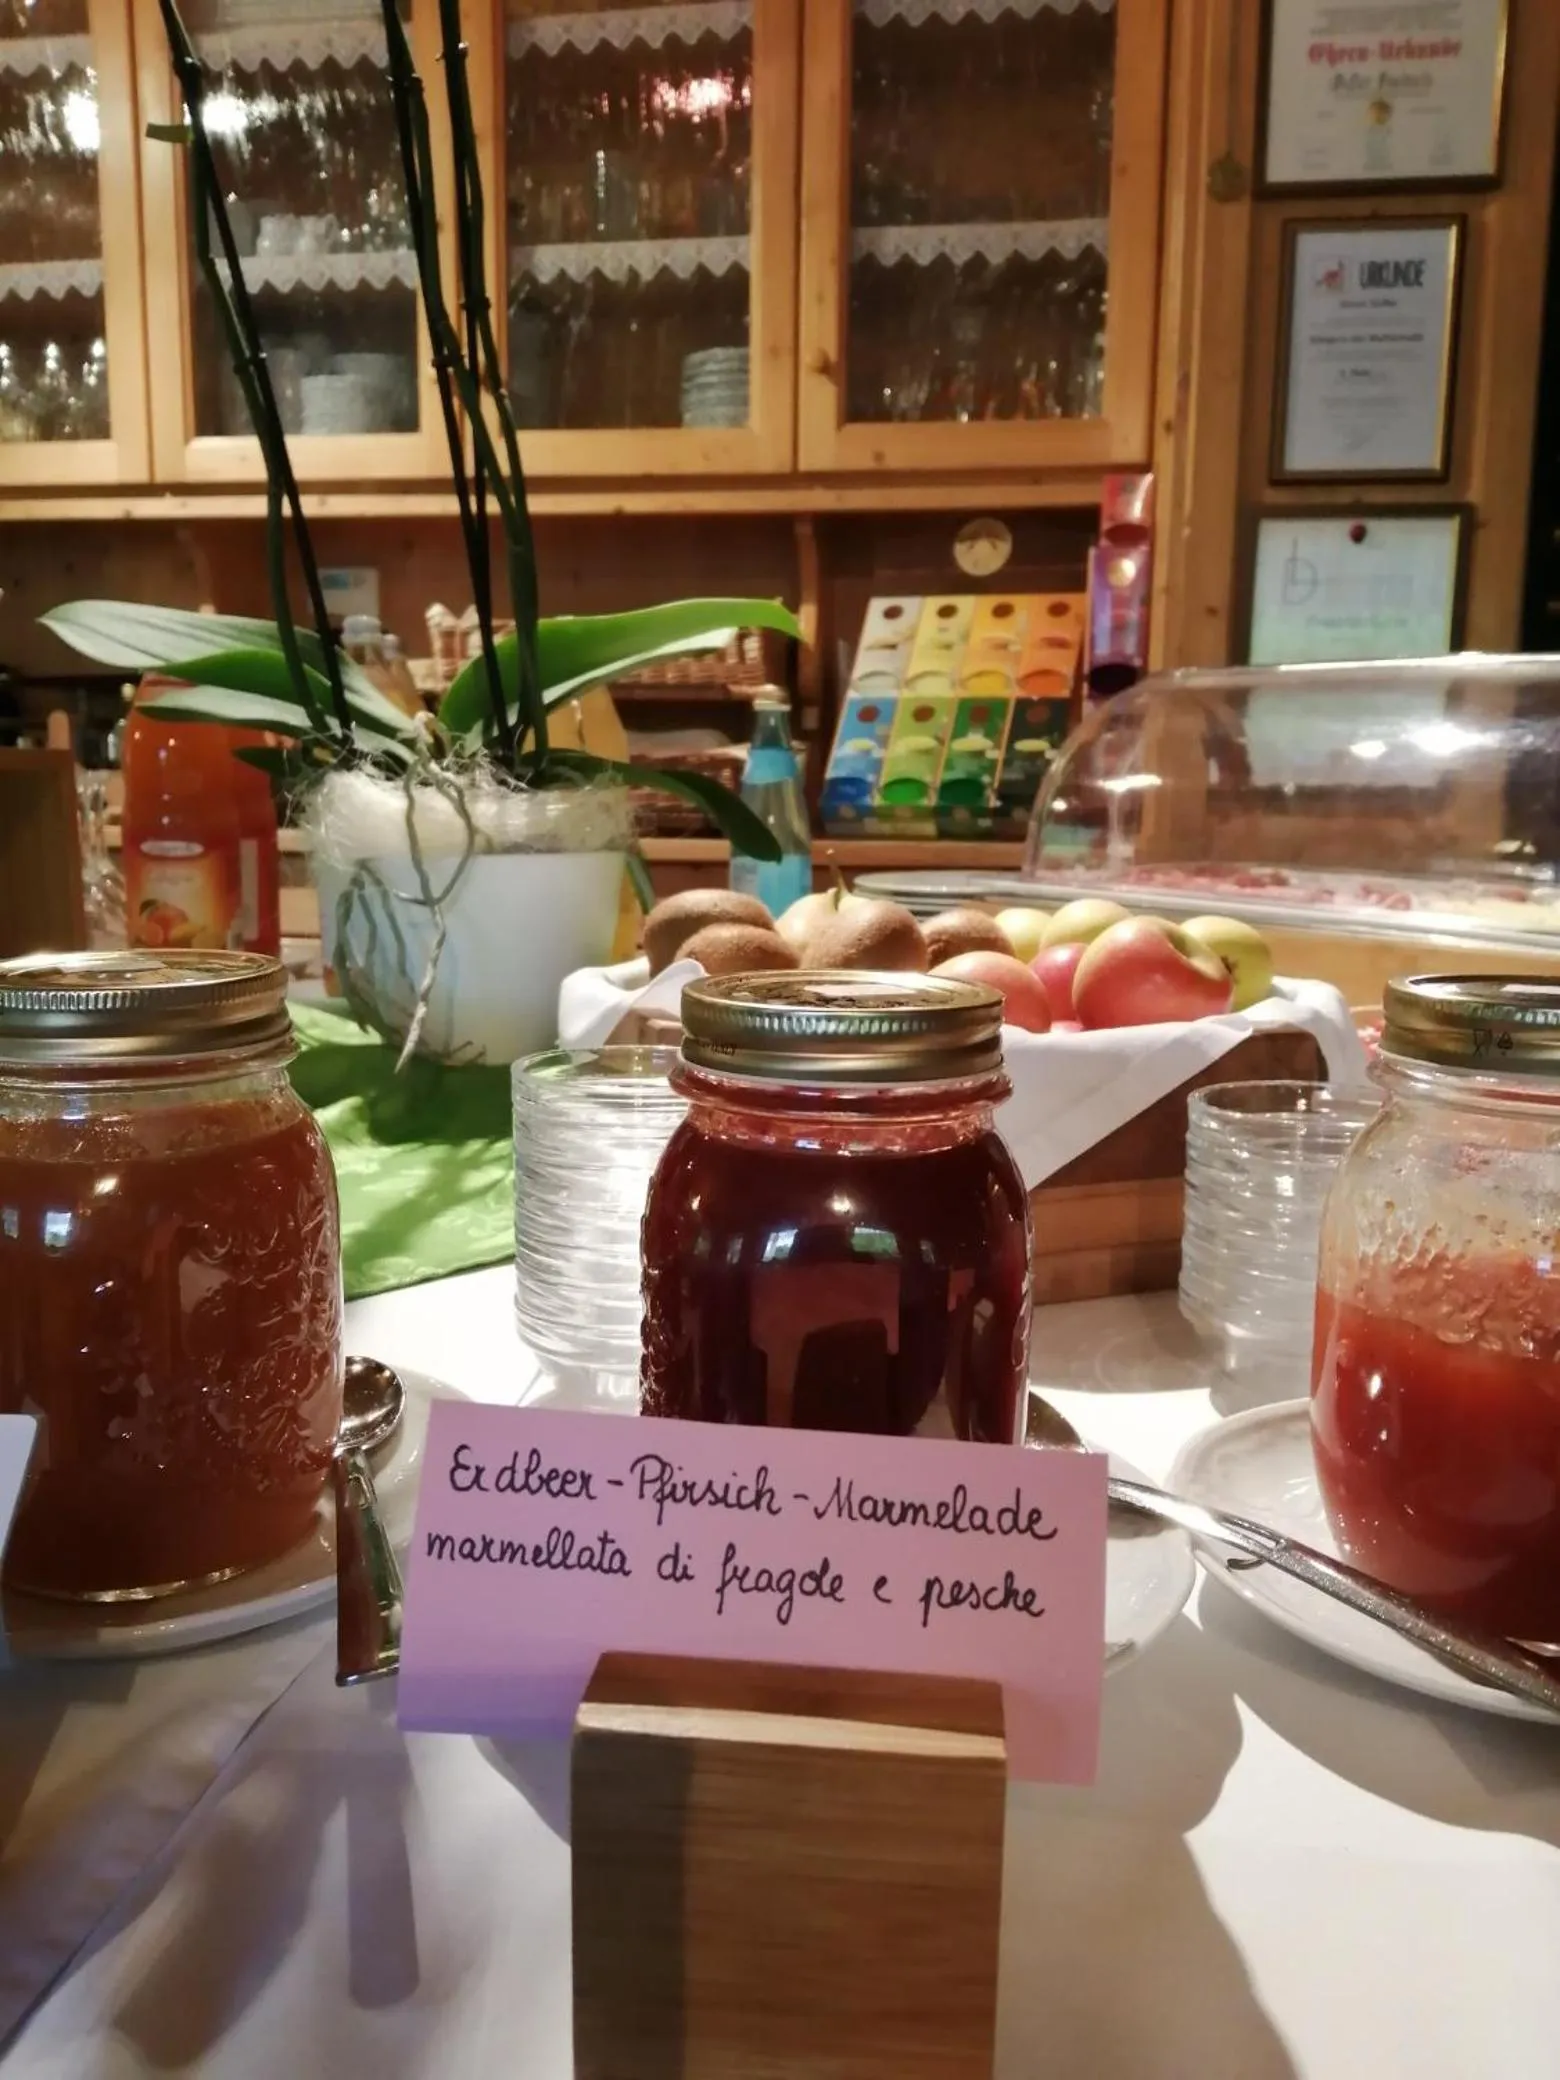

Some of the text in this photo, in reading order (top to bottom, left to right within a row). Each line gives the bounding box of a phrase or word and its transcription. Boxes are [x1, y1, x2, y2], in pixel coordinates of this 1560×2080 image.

[426, 1526, 1045, 1628] marmellata di fragole e pesche
